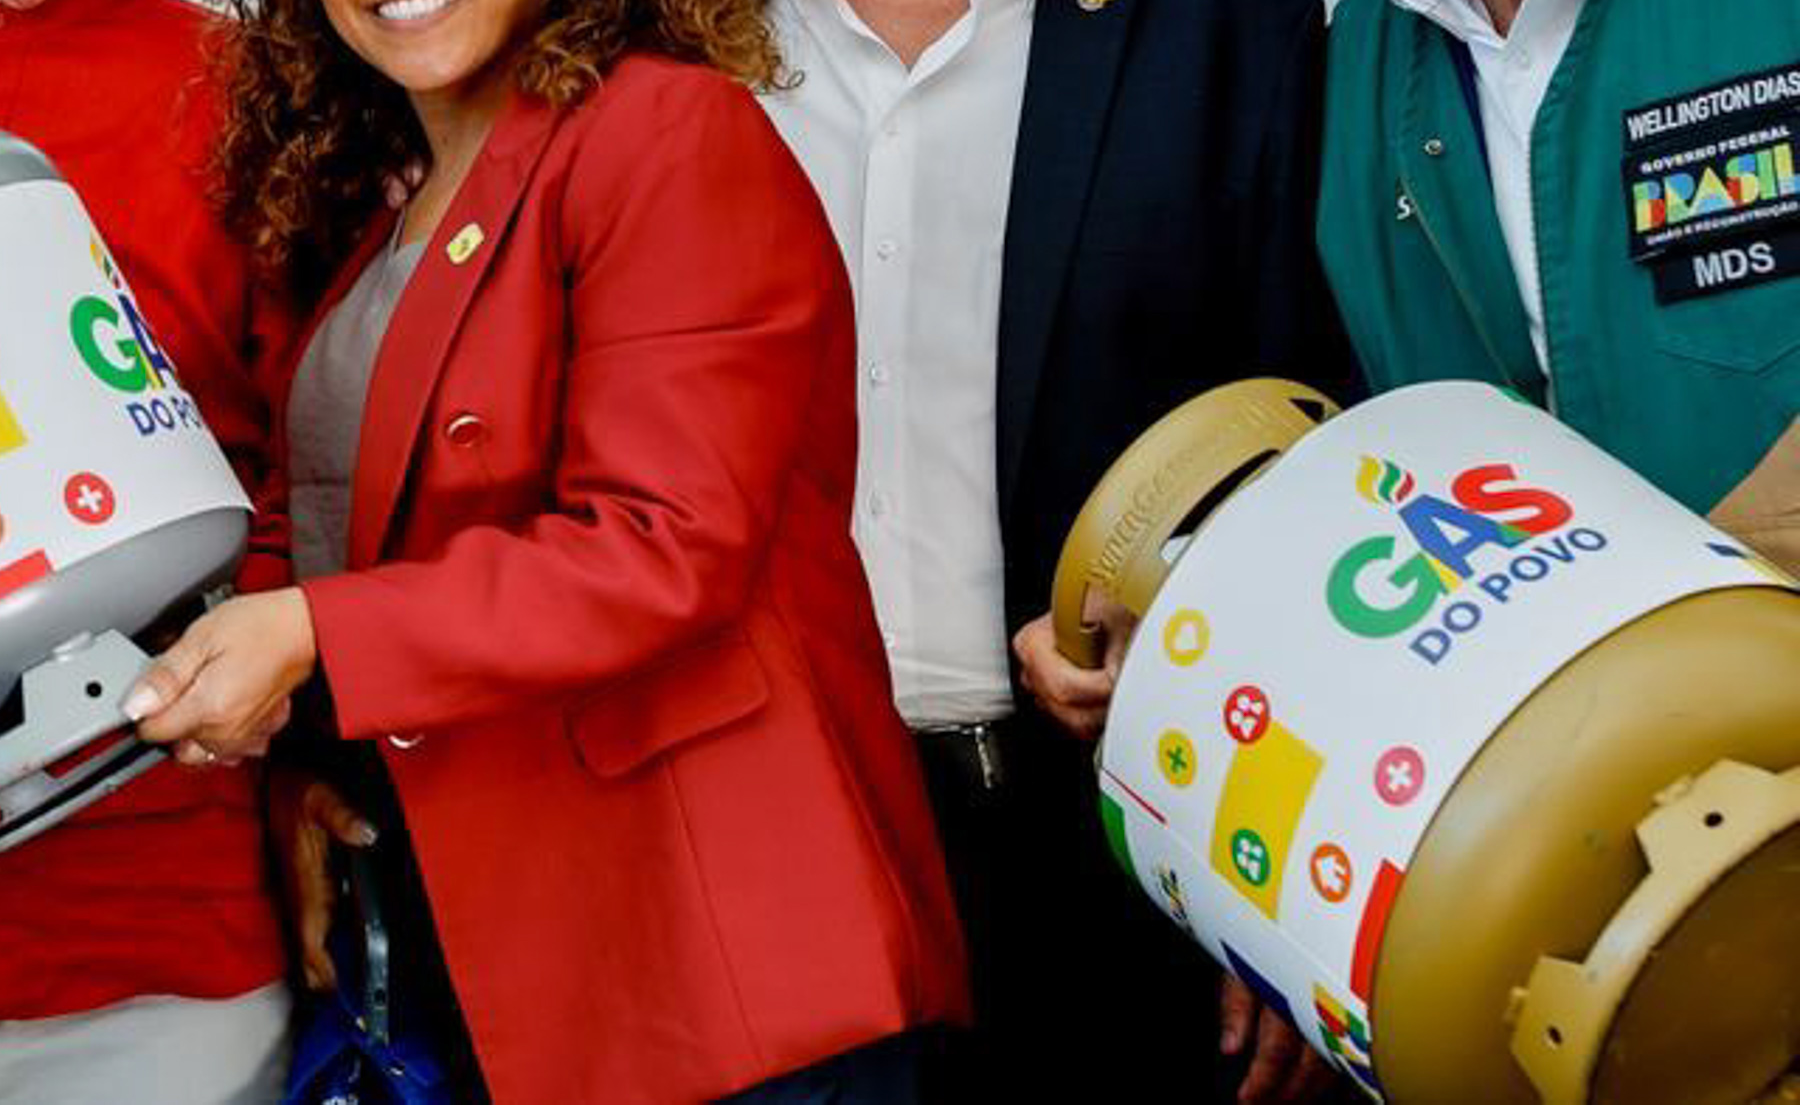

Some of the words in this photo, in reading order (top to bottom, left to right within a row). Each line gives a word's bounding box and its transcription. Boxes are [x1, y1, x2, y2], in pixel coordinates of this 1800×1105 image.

[1627, 83, 1750, 141] WELLINGTON
[1753, 71, 1800, 105] DIAS
[1632, 142, 1800, 234] BRASIL
[1692, 241, 1775, 288] MDS
[126, 398, 175, 435] DO
[1408, 600, 1482, 666] DO
[1478, 527, 1608, 604] POVO
